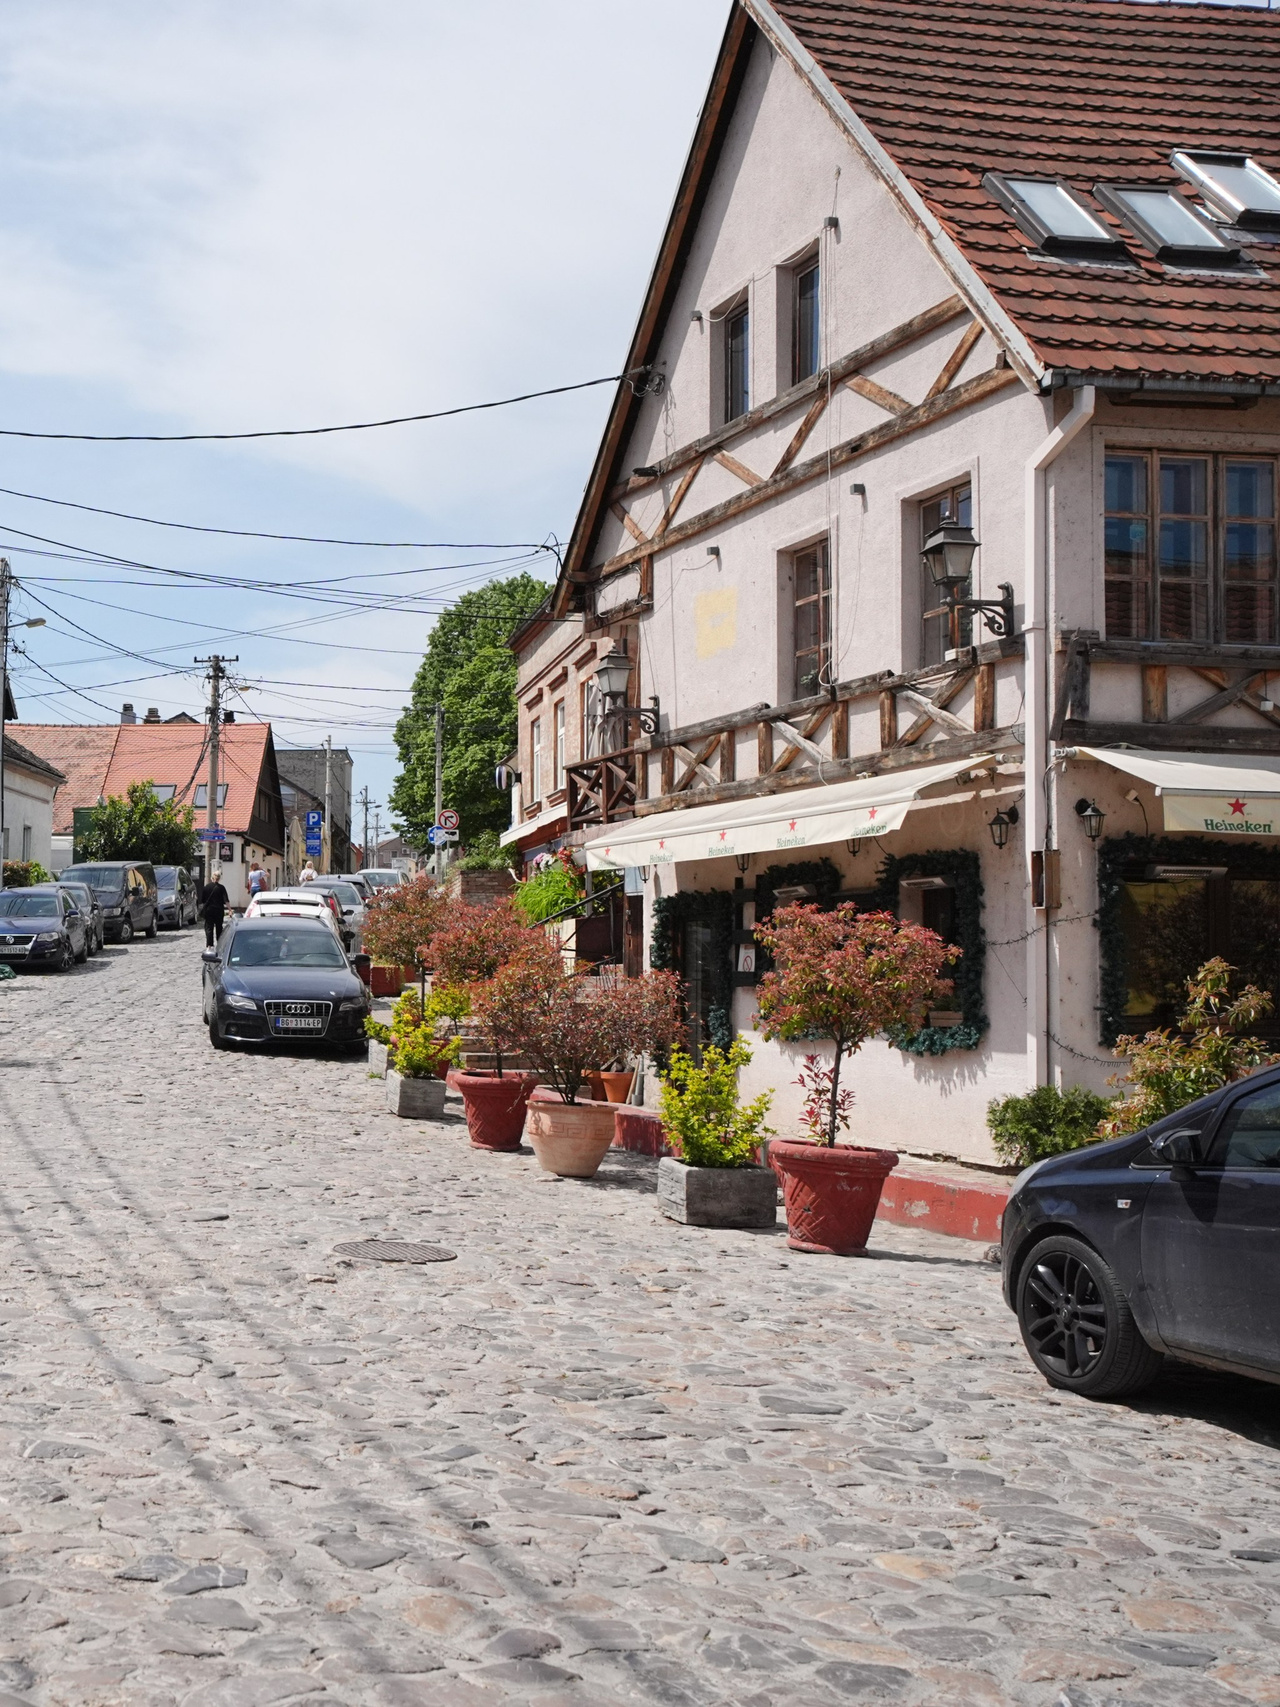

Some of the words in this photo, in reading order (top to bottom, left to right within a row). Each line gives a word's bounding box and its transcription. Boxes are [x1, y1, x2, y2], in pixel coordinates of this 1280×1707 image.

[309, 813, 319, 825] P
[1204, 819, 1272, 833] Heineken
[776, 836, 806, 848] Heineken
[708, 845, 735, 857] Heineken
